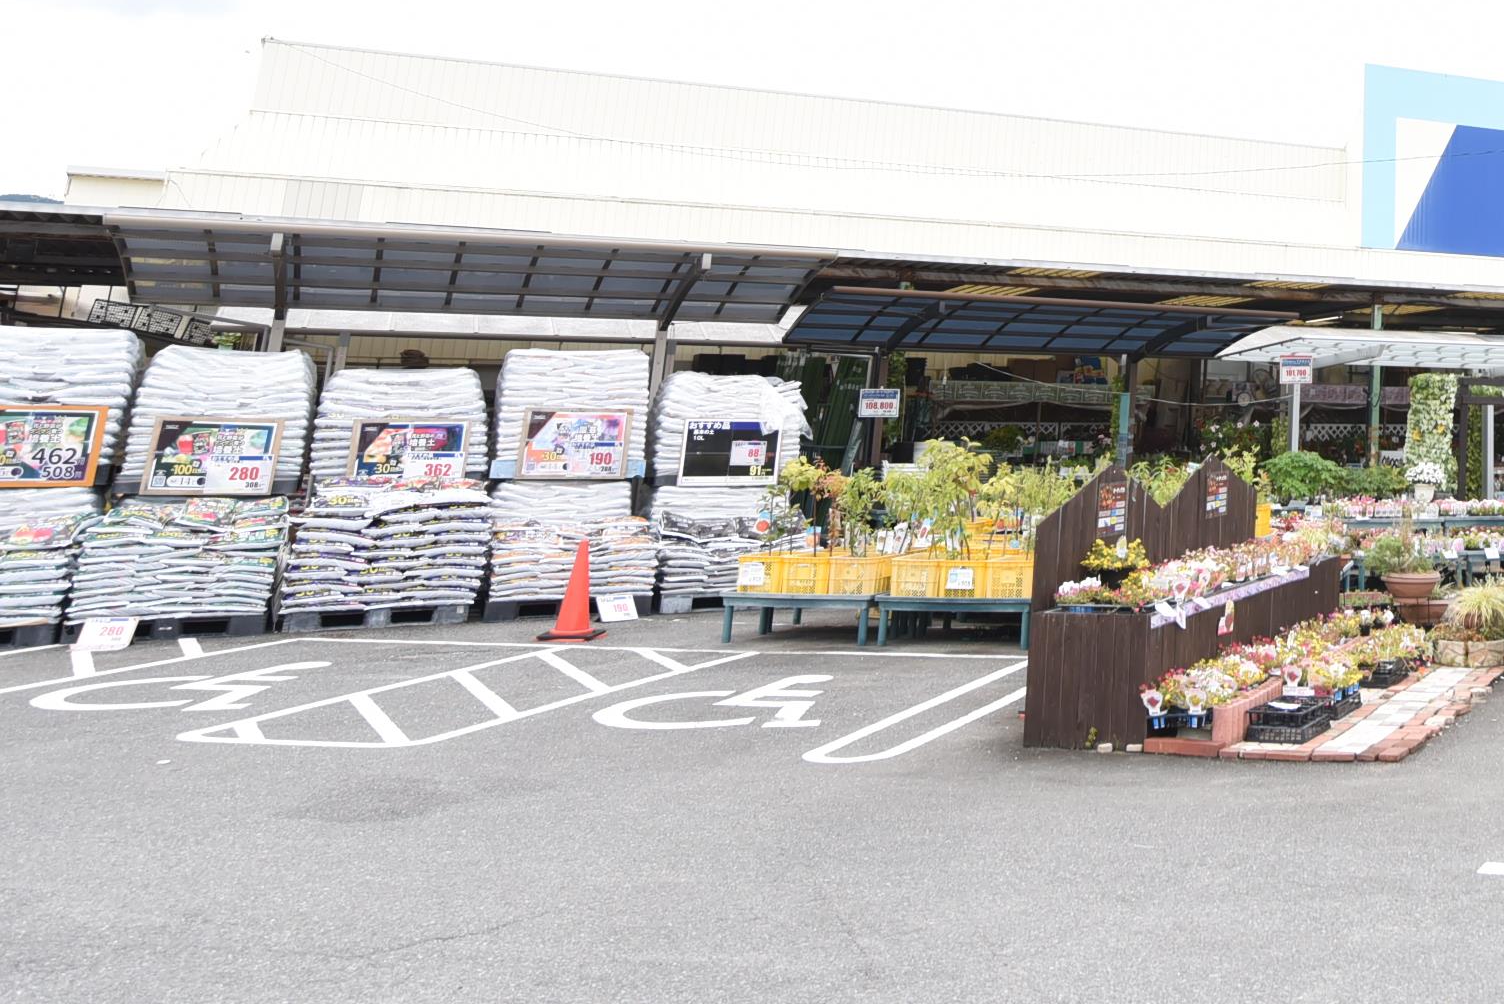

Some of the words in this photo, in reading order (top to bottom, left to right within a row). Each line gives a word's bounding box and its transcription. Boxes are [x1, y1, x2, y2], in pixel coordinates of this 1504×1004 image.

[689, 422, 731, 430] おすすめ品
[589, 452, 613, 466] 190
[228, 466, 260, 481] 280
[424, 463, 452, 477] 362
